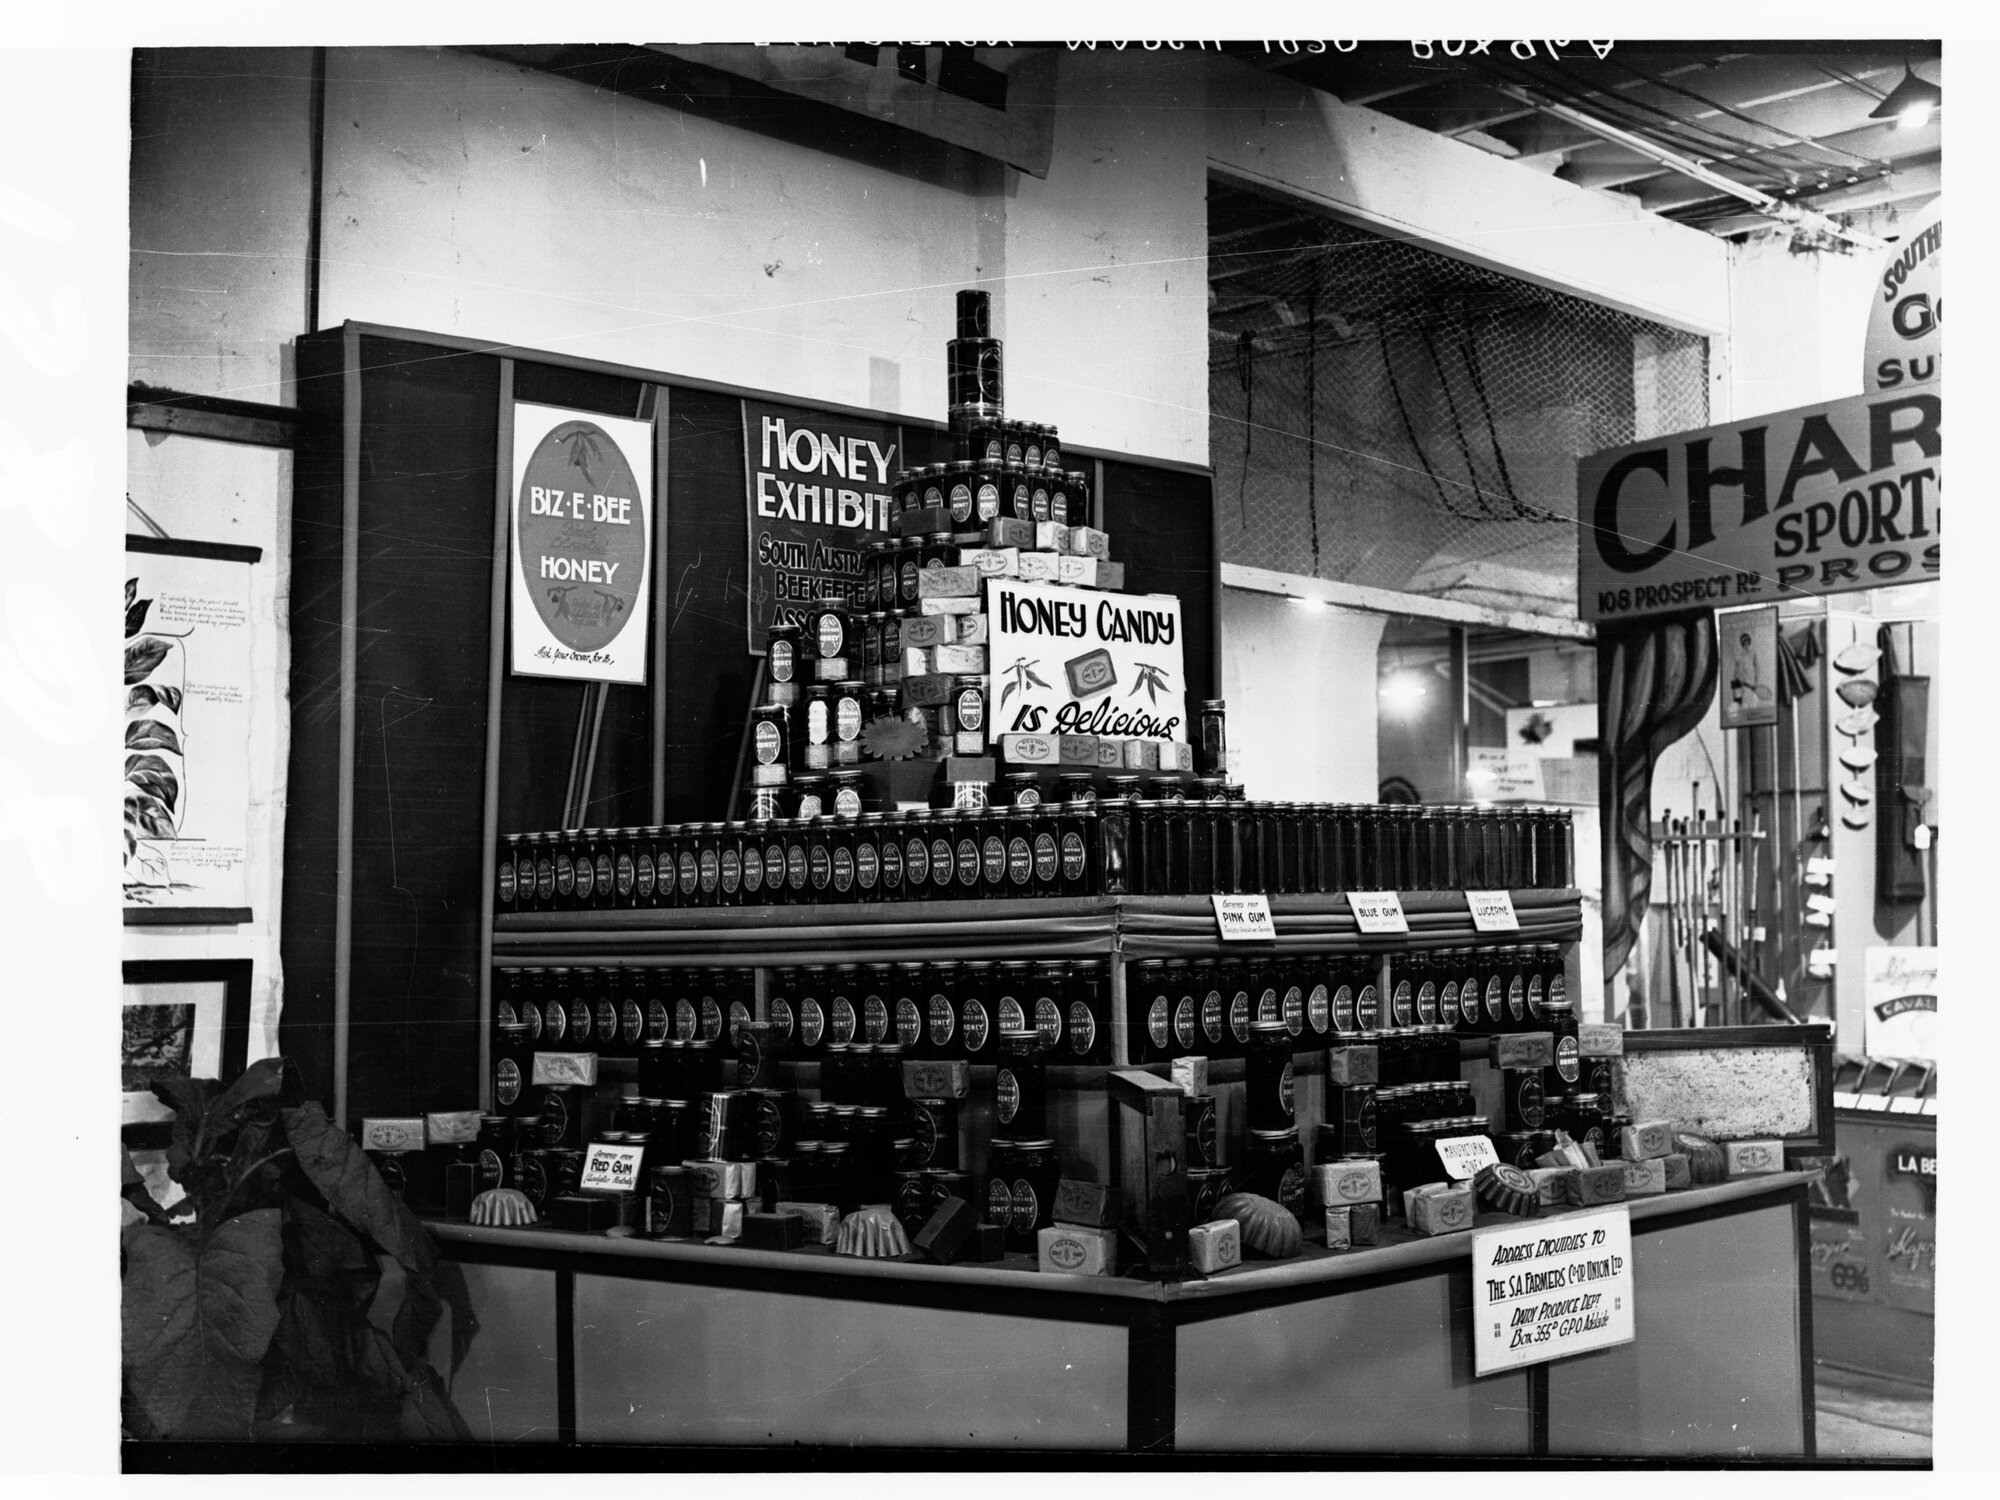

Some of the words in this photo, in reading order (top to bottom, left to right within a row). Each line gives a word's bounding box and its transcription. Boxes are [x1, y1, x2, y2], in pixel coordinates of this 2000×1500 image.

[1892, 293, 1941, 340] G
[762, 415, 896, 484] HONEY
[757, 471, 892, 532] EXHIBIT
[1593, 394, 1941, 573] CHAR
[1774, 467, 1941, 558] SPORT
[758, 531, 809, 570] SOUTH
[540, 555, 620, 585] HONEY
[1598, 589, 1632, 613] 108
[1635, 576, 1732, 609] PROSPECT
[1000, 591, 1087, 638] HONEY
[1096, 600, 1175, 645] CANDY
[1011, 704, 1048, 732] IS
[1050, 696, 1180, 742] Delicious
[1223, 912, 1244, 922] PINK
[1249, 912, 1266, 922] GUM
[1358, 908, 1379, 917] BLUE
[1382, 907, 1398, 916] GUM
[591, 1158, 610, 1171] RED
[612, 1160, 632, 1174] GUM
[1898, 1155, 1918, 1173] LA
[1492, 1243, 1535, 1266] ADDRESS
[1535, 1233, 1588, 1258] ENQUIRIES
[1592, 1229, 1606, 1246] TO
[1487, 1279, 1506, 1302] THE
[1587, 1259, 1609, 1281] UNION
[1510, 1305, 1539, 1327] DAIRY
[1538, 1297, 1580, 1321] PRODUCE
[1509, 1328, 1532, 1349] Box
